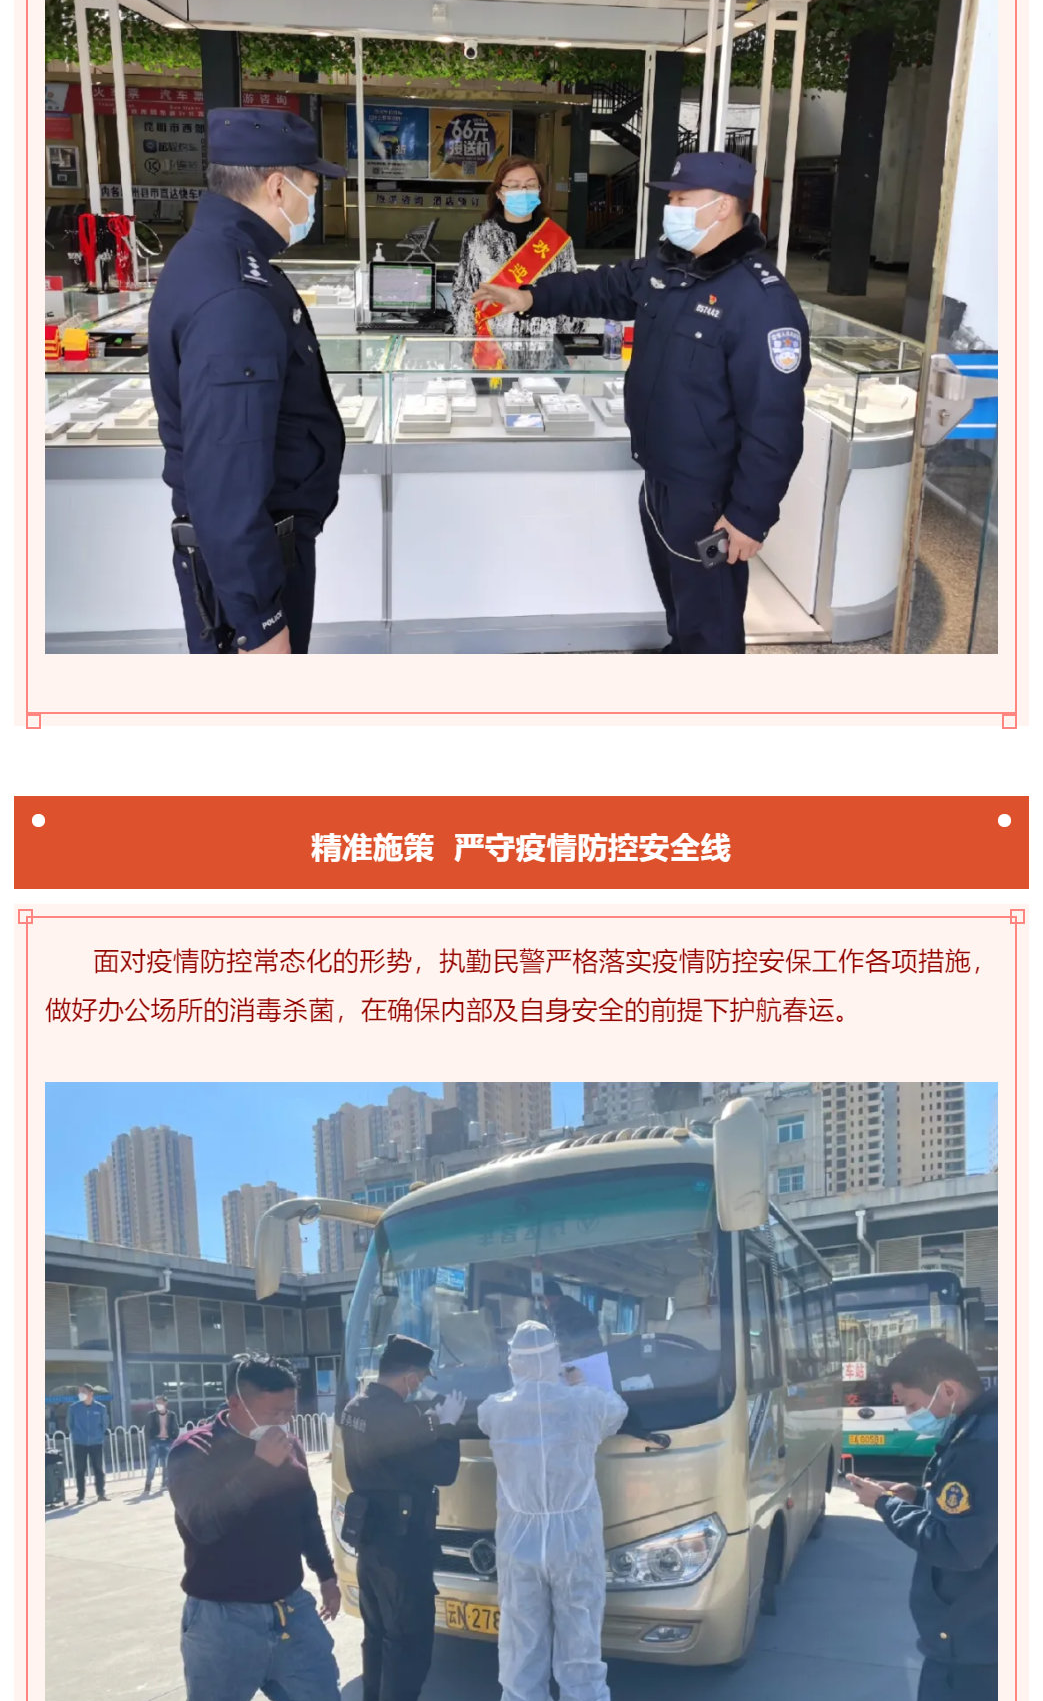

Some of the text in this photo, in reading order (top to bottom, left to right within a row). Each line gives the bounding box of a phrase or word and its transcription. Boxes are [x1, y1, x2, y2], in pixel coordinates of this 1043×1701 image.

[93, 86, 140, 100] 火票
[452, 118, 488, 142] 66元
[101, 185, 199, 200] 内各州县市直达快车
[312, 832, 732, 863] 精准施策 严守疫情防控安全线
[93, 947, 982, 975] 面对疫情防控常态化的形势，执勤民警严格落实疫情防控安保工作各项措施，
[44, 996, 847, 1024] 做好办公场所的消毒杀菌，在确保内部及自身安全的前提下护航春运。
